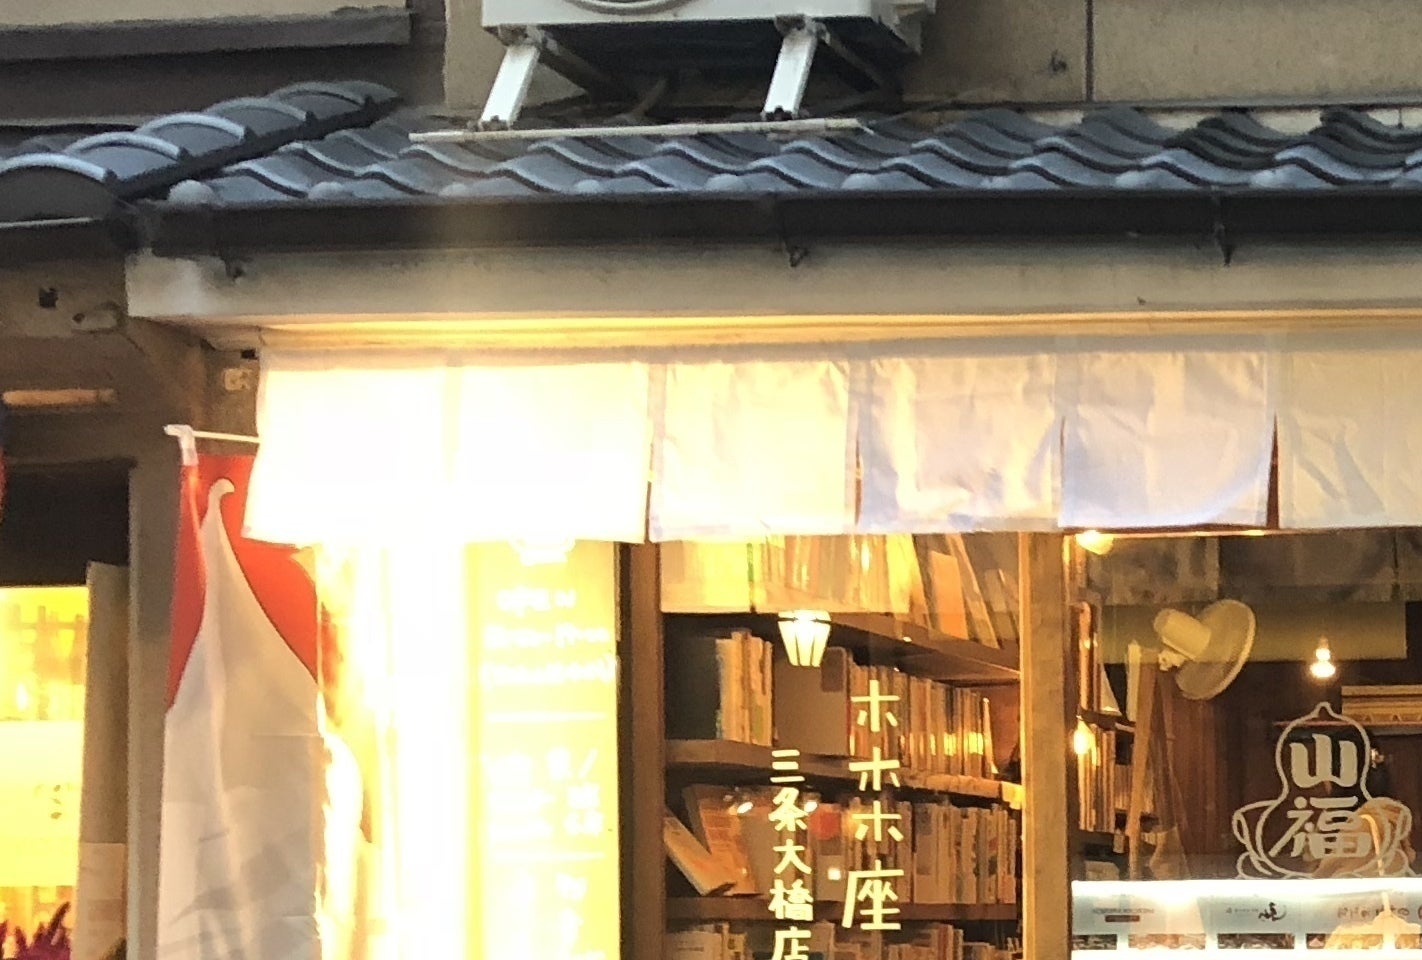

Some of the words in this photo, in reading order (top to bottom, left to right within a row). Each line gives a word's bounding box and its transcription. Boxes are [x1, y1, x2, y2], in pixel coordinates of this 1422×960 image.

[841, 680, 905, 931] ホホホ座
[1269, 732, 1372, 860] 山福
